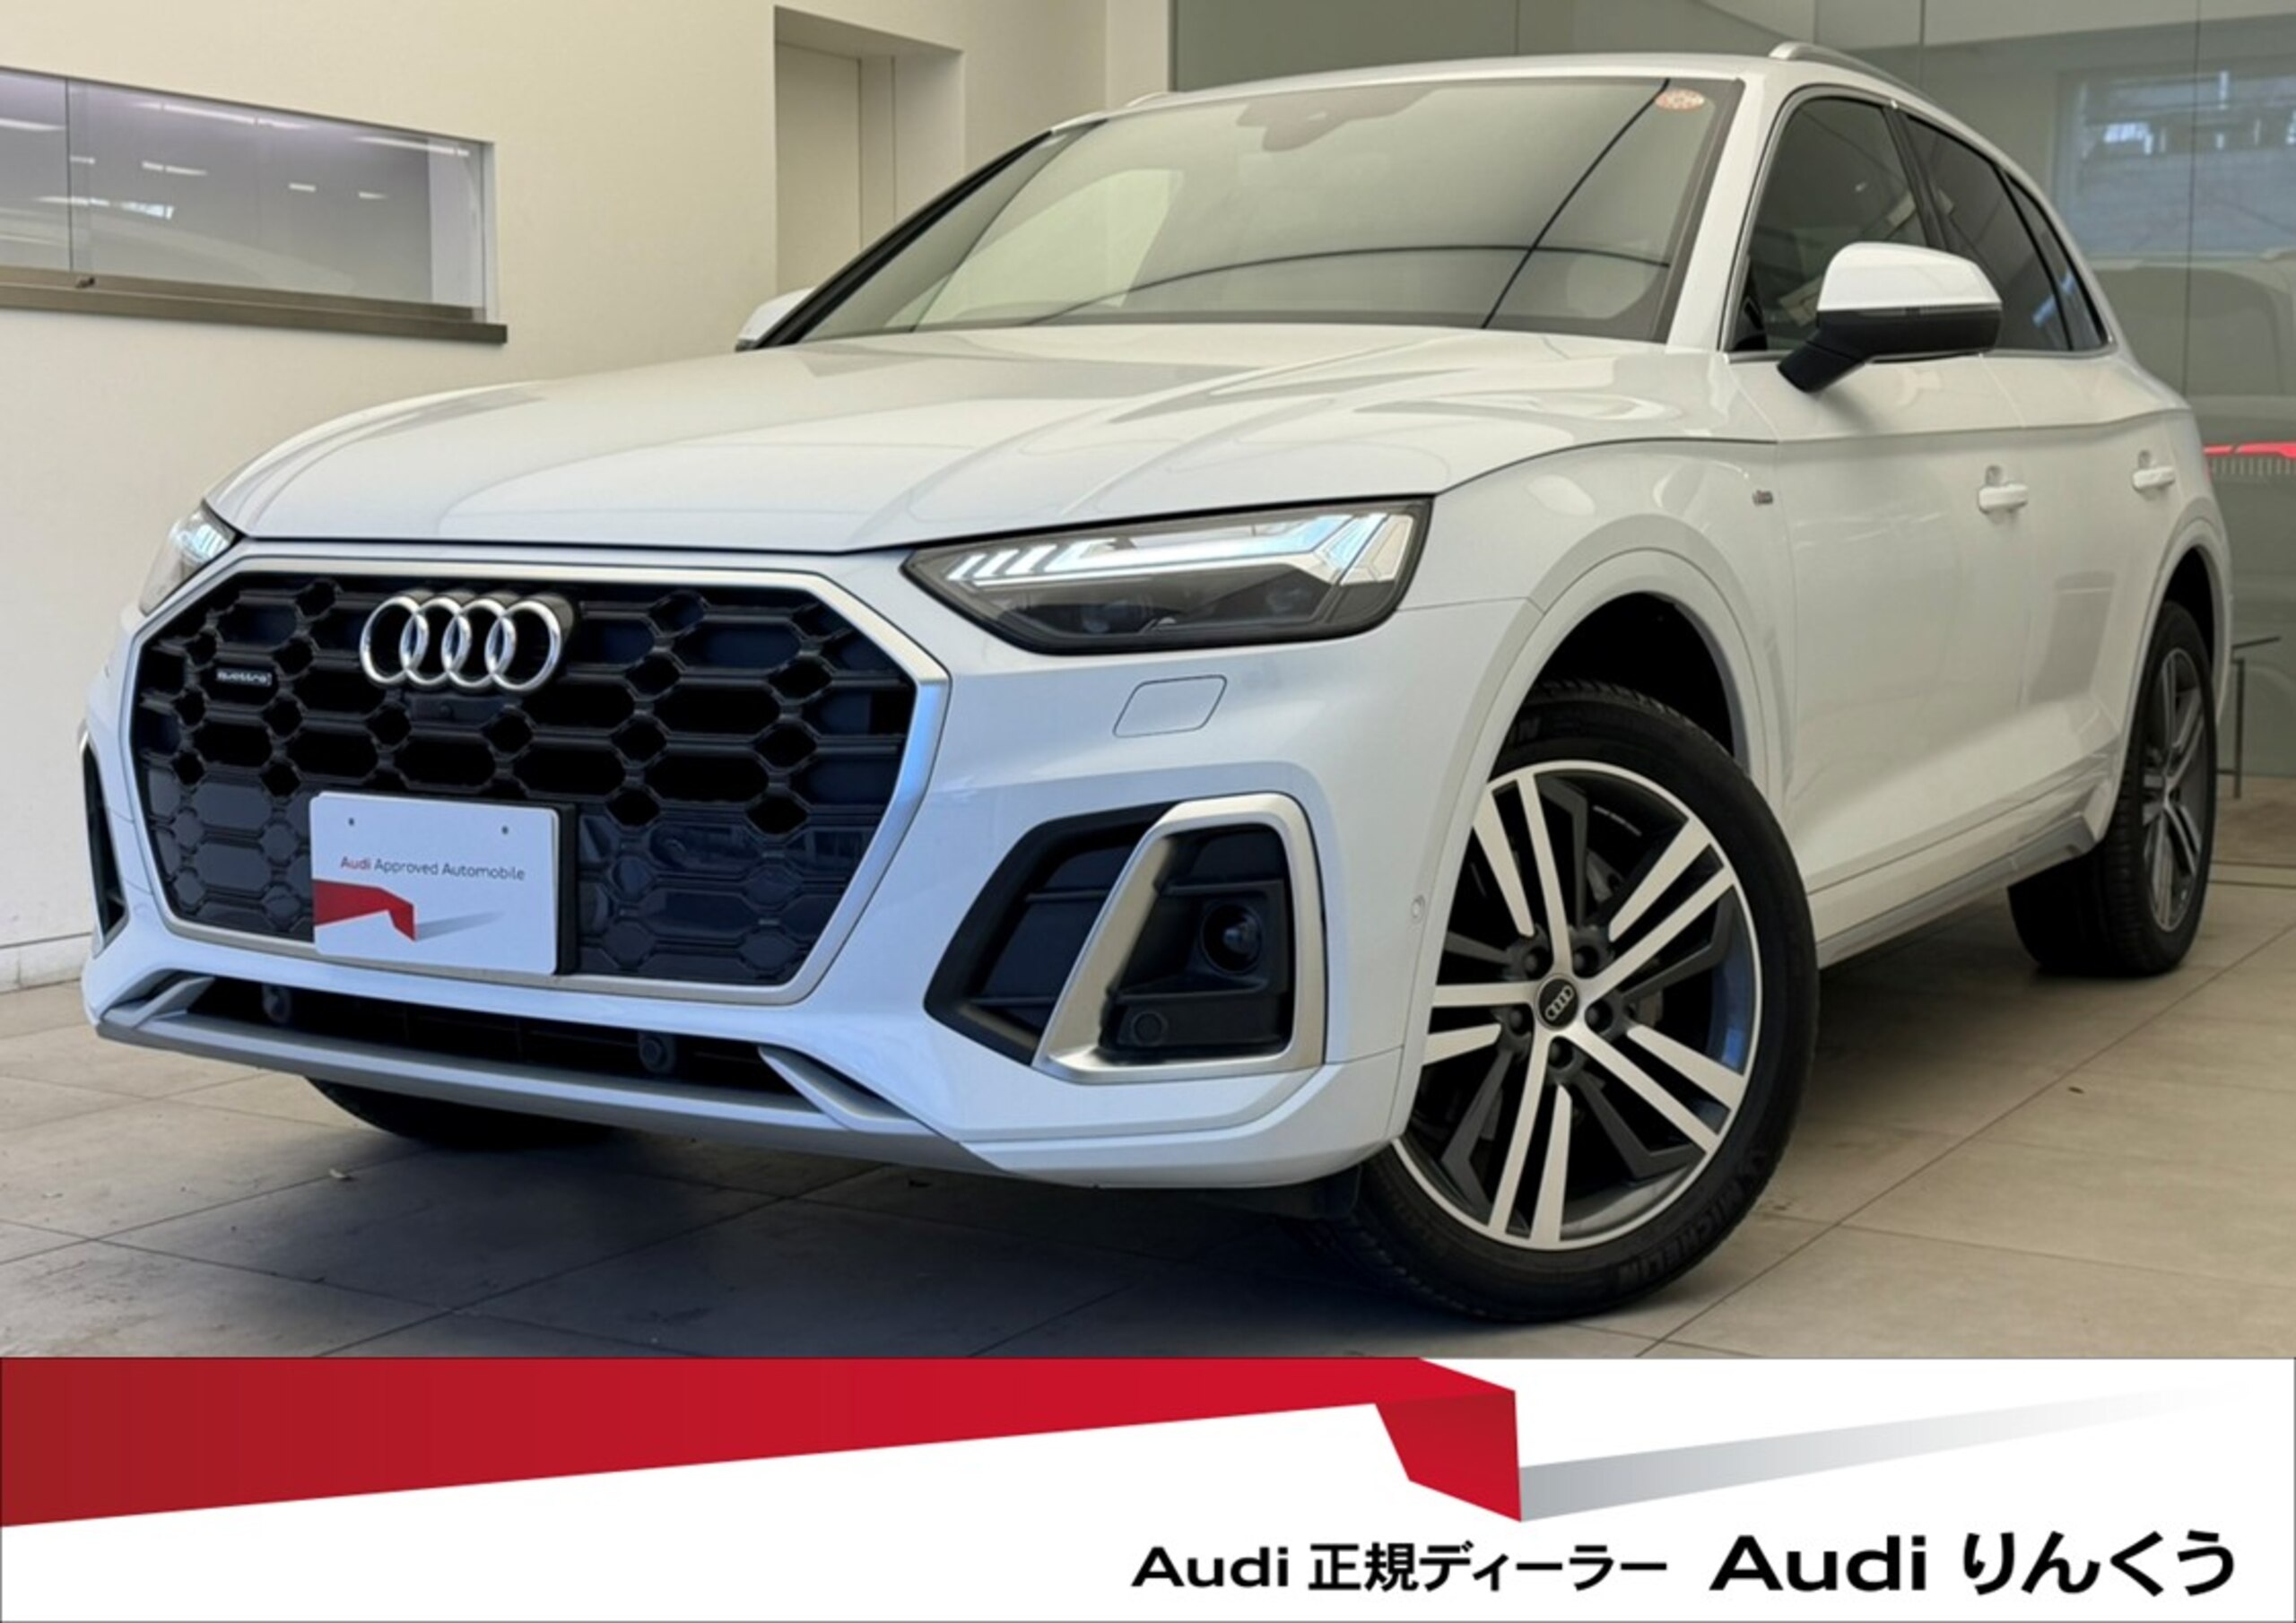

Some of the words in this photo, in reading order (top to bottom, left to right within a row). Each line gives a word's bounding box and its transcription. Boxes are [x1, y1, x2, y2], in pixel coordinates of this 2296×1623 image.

[340, 856, 371, 870] Audi
[374, 858, 439, 875] Approved
[442, 863, 526, 881] Automobile
